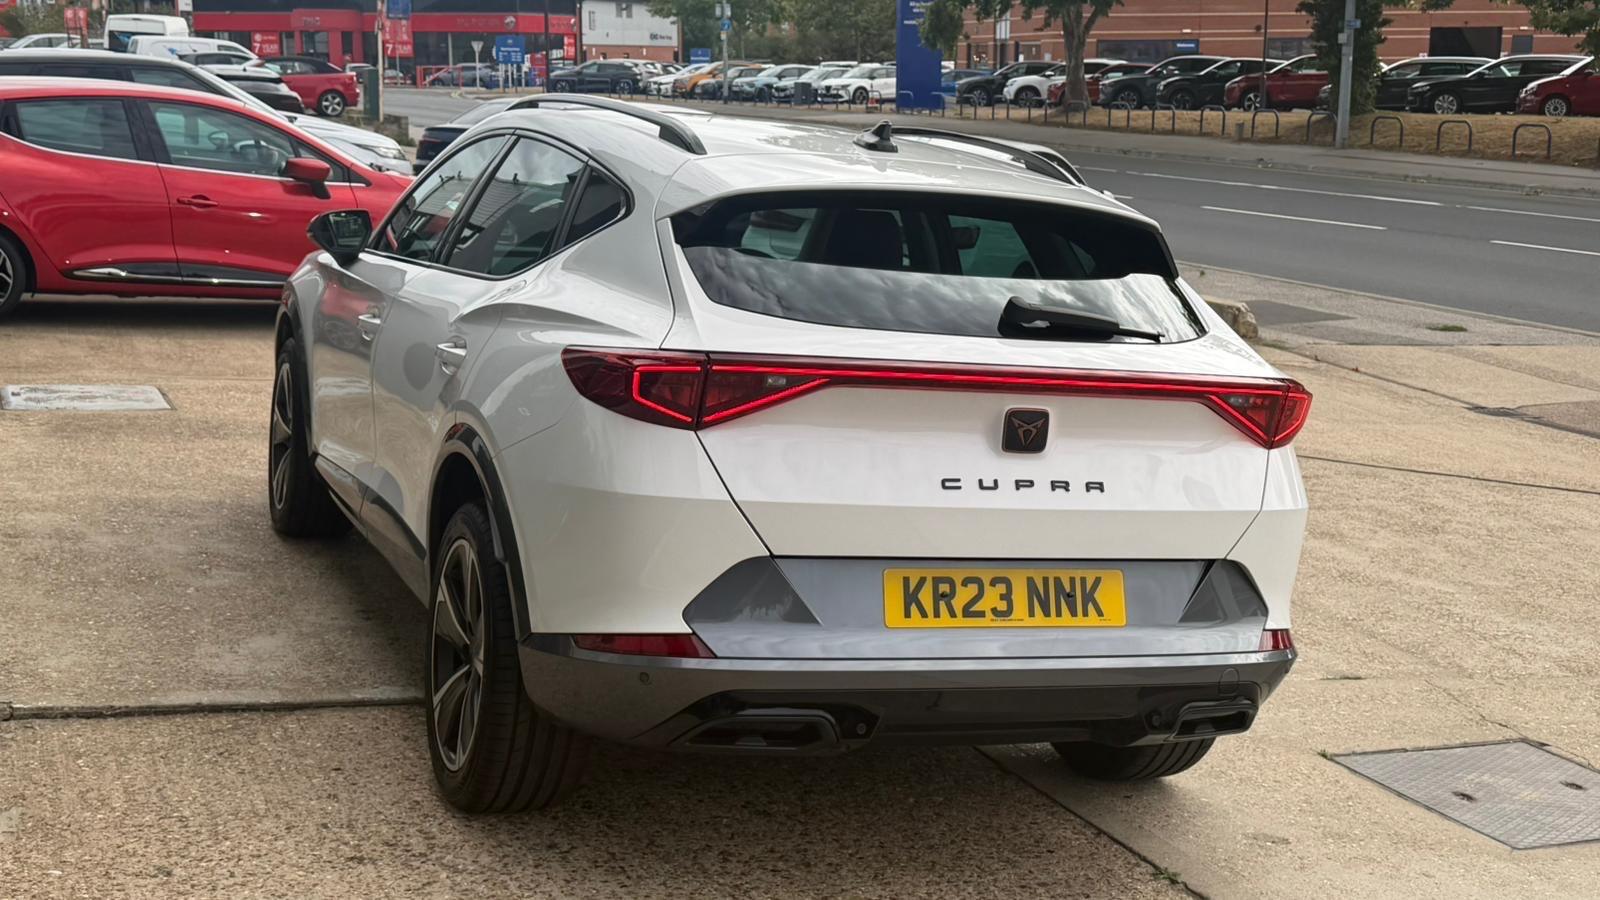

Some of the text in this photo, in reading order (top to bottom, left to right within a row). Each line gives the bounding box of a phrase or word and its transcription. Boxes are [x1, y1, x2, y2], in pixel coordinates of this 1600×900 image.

[253, 42, 261, 54] 7
[385, 43, 393, 54] 7
[941, 478, 1105, 493] CUPRA
[902, 576, 1104, 618] KR23 NNK
